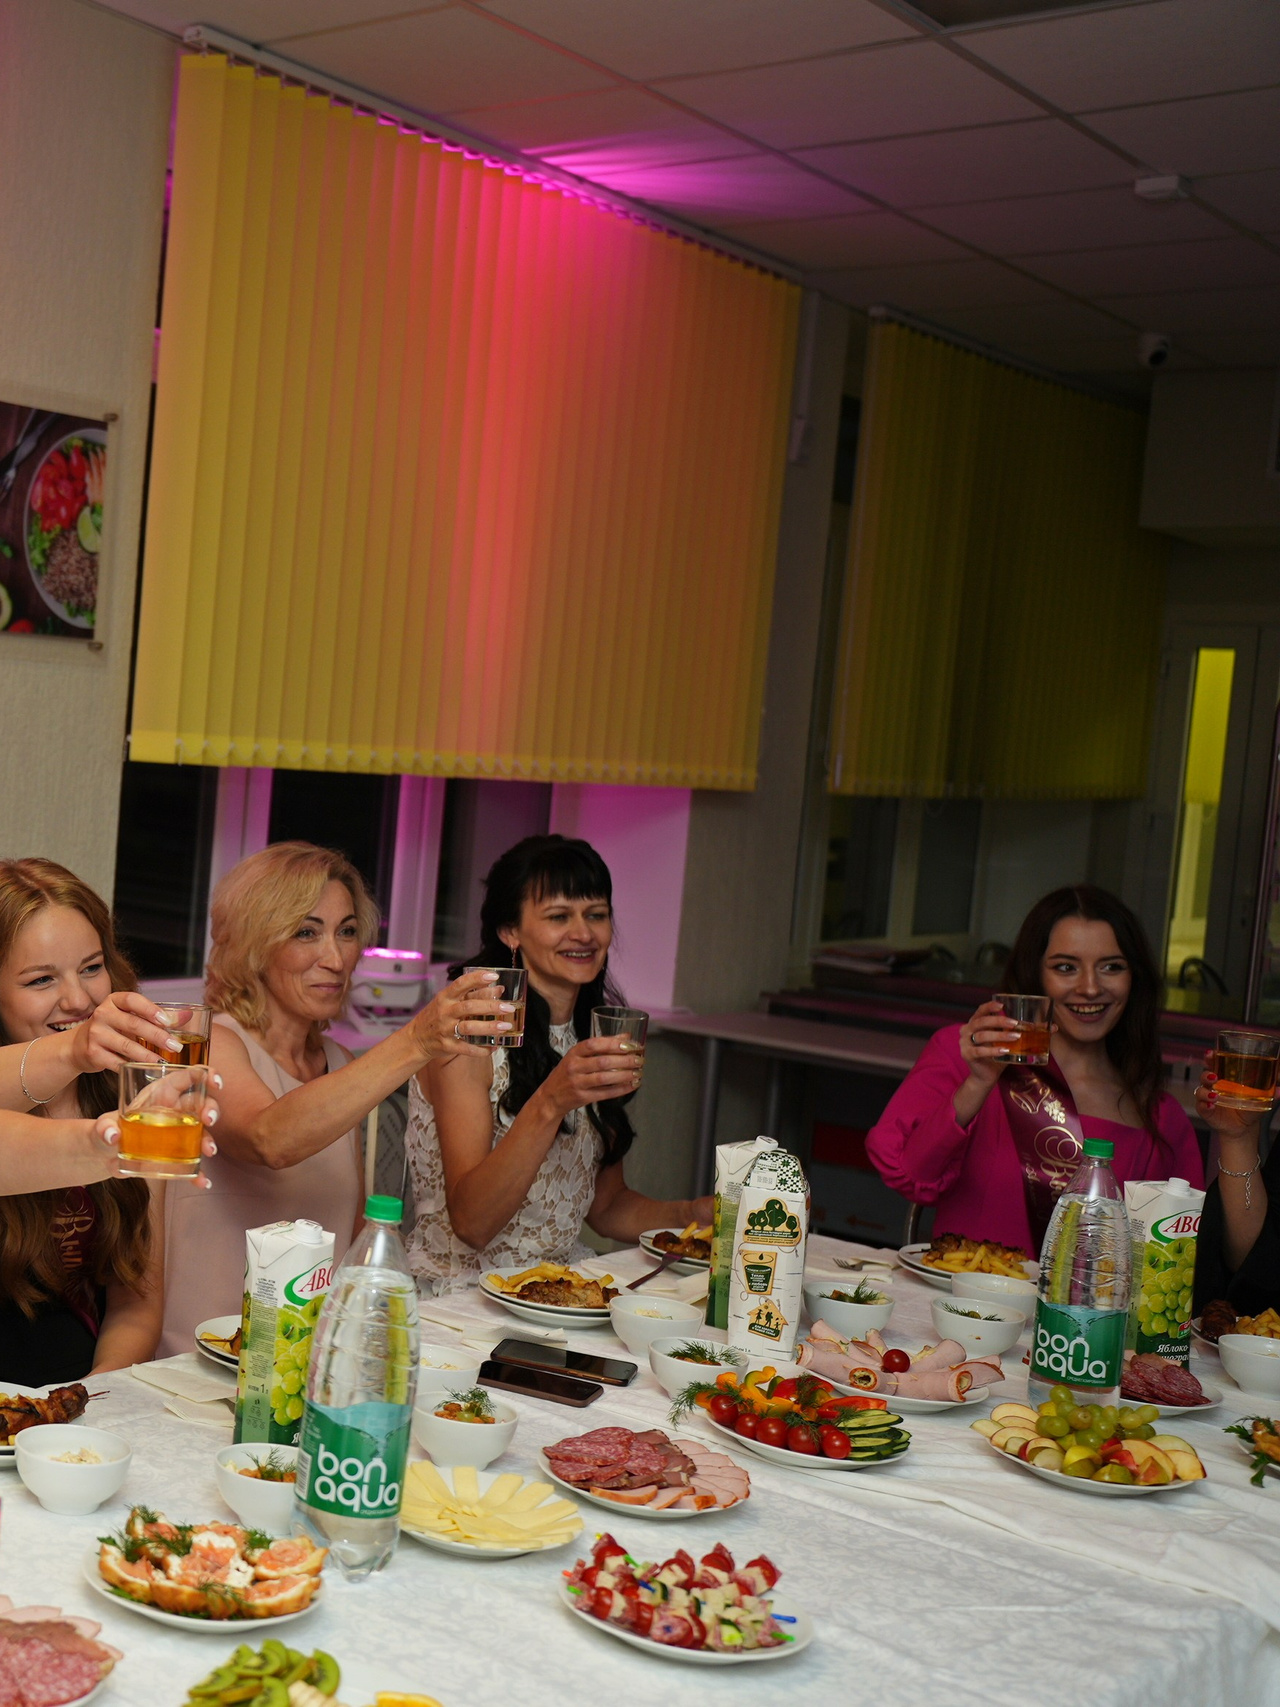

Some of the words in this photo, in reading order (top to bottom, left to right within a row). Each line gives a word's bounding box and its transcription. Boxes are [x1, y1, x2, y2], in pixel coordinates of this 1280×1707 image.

[1037, 1323, 1090, 1358] bon
[1035, 1347, 1107, 1379] aqua
[317, 1443, 388, 1483] bon
[314, 1475, 400, 1513] aqua
